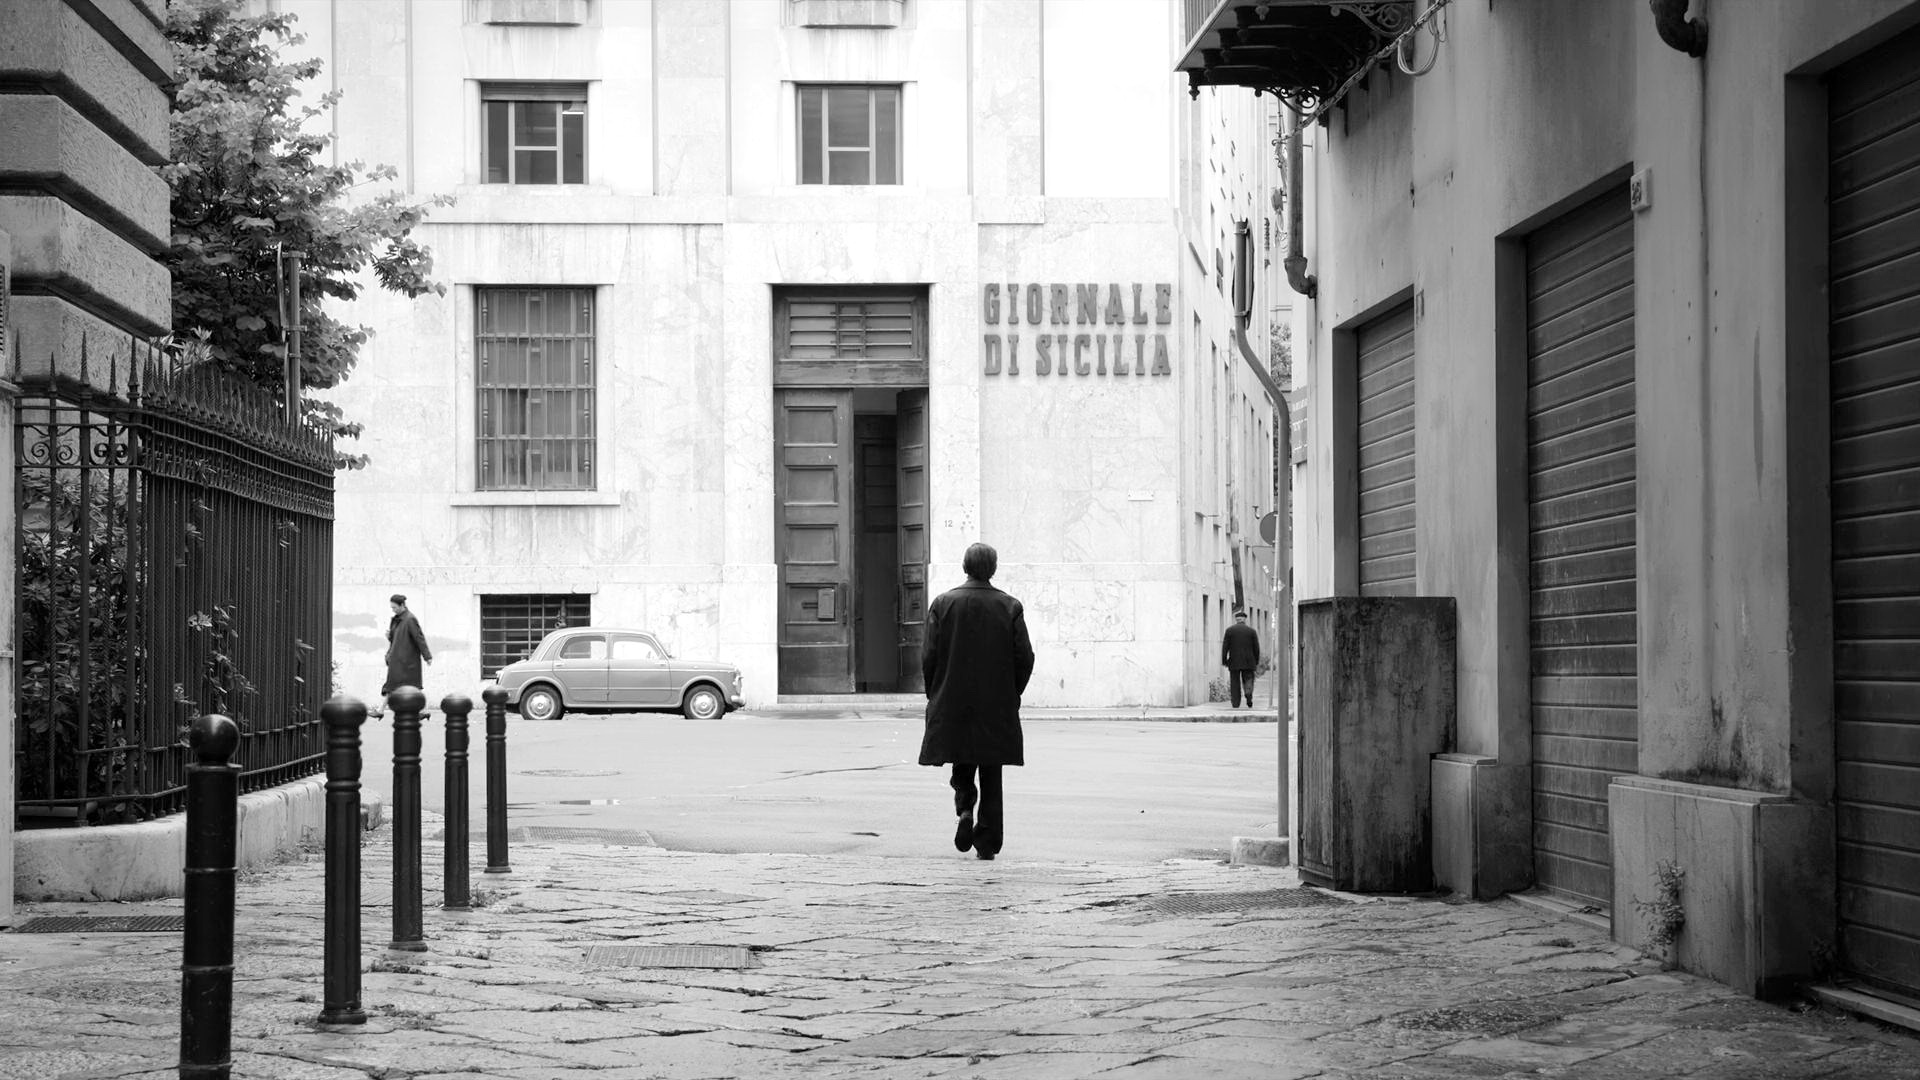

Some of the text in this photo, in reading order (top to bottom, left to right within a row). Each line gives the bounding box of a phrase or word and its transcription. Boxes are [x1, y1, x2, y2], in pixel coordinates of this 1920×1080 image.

[984, 283, 1171, 325] GIORNALE
[984, 334, 1171, 376] DI SICILIA
[944, 519, 953, 528] 12
